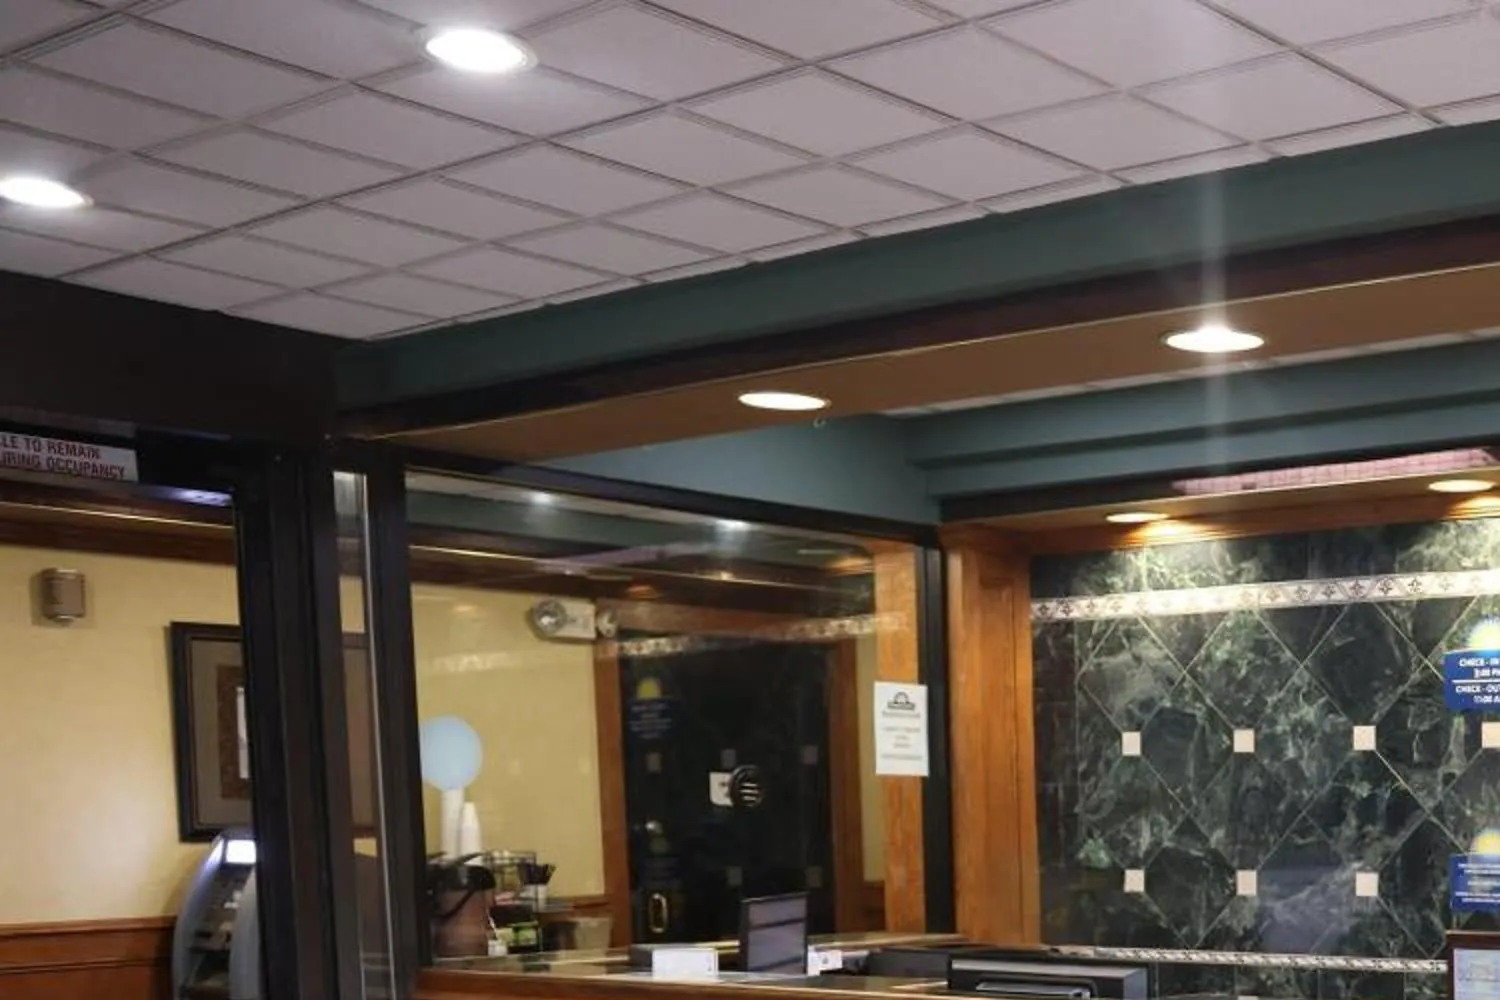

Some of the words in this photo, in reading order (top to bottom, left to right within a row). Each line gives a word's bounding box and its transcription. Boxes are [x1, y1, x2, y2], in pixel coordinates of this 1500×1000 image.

[24, 437, 41, 453] TO
[47, 441, 101, 459] REMAIN
[46, 456, 125, 480] OCCUPANCY
